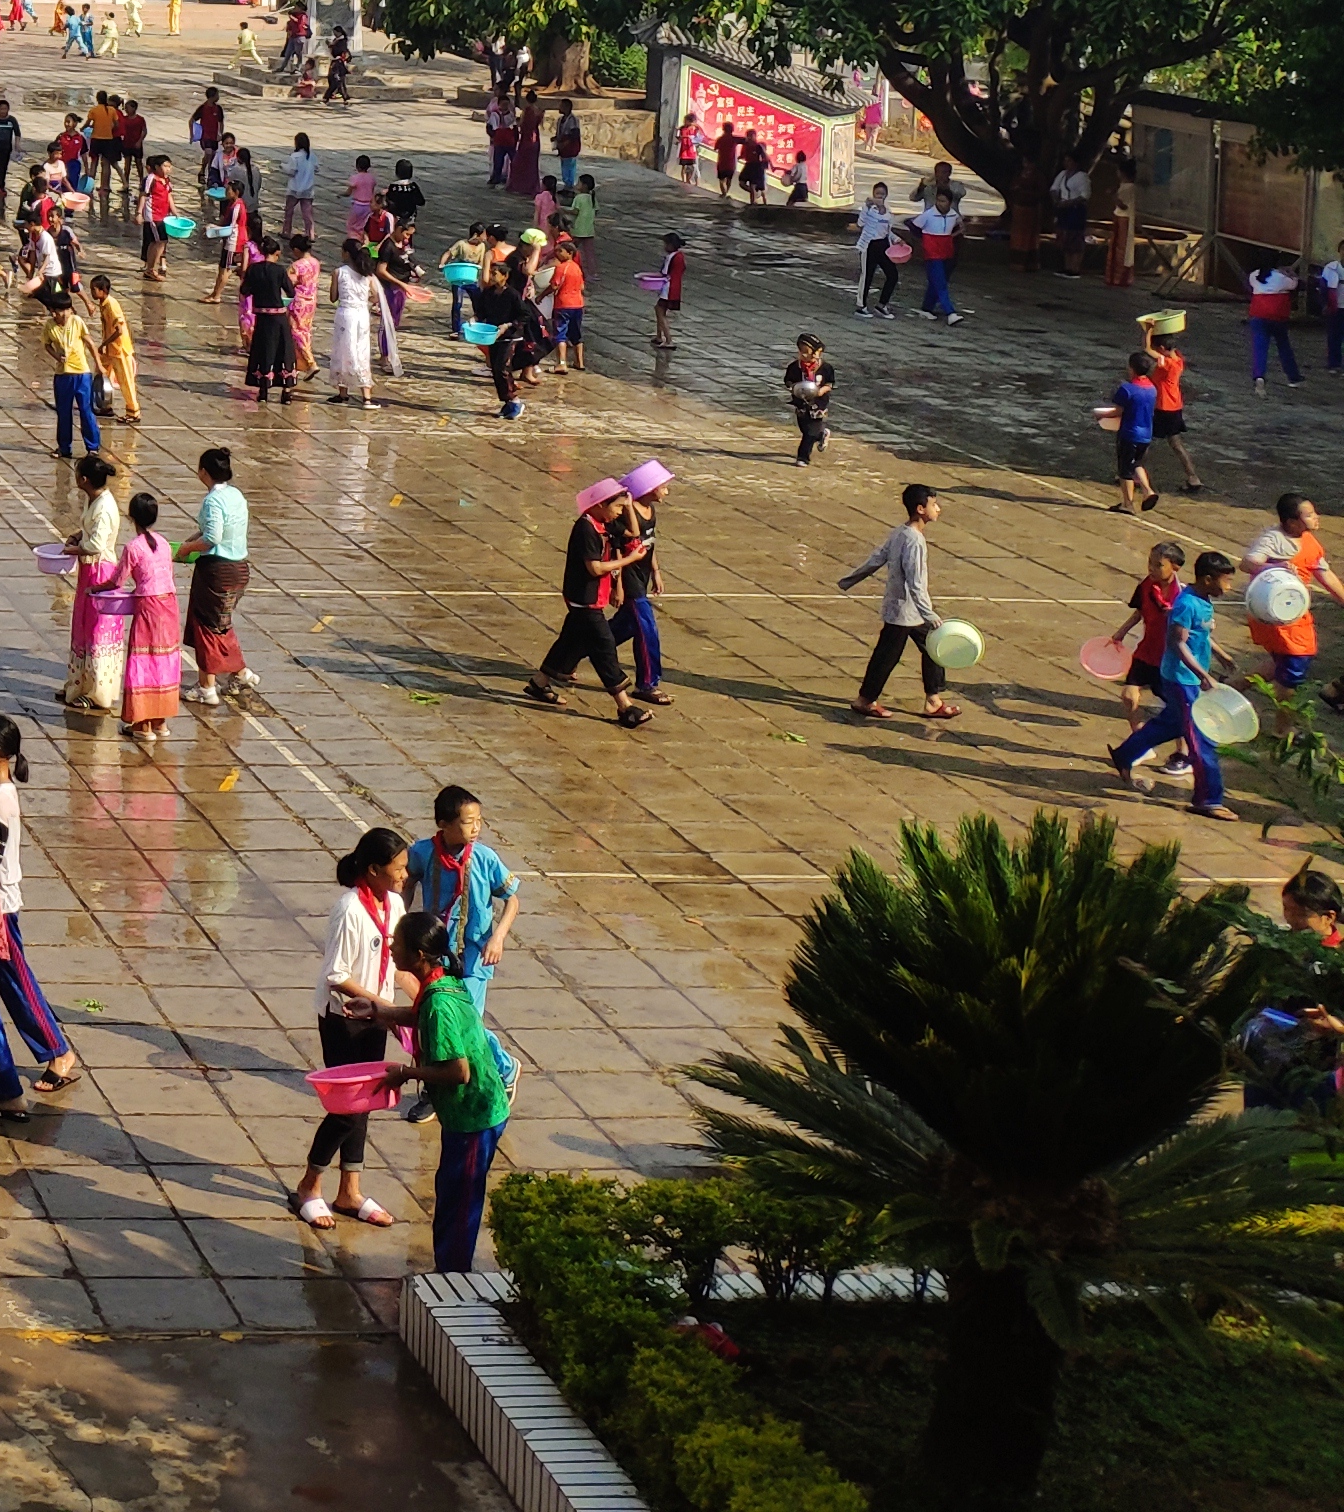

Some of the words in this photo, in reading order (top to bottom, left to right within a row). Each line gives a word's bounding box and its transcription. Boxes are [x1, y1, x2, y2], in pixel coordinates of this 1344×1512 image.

[716, 97, 735, 108] 富强
[737, 106, 755, 117] 民主
[757, 115, 775, 125] 文明
[757, 130, 774, 140] 公正
